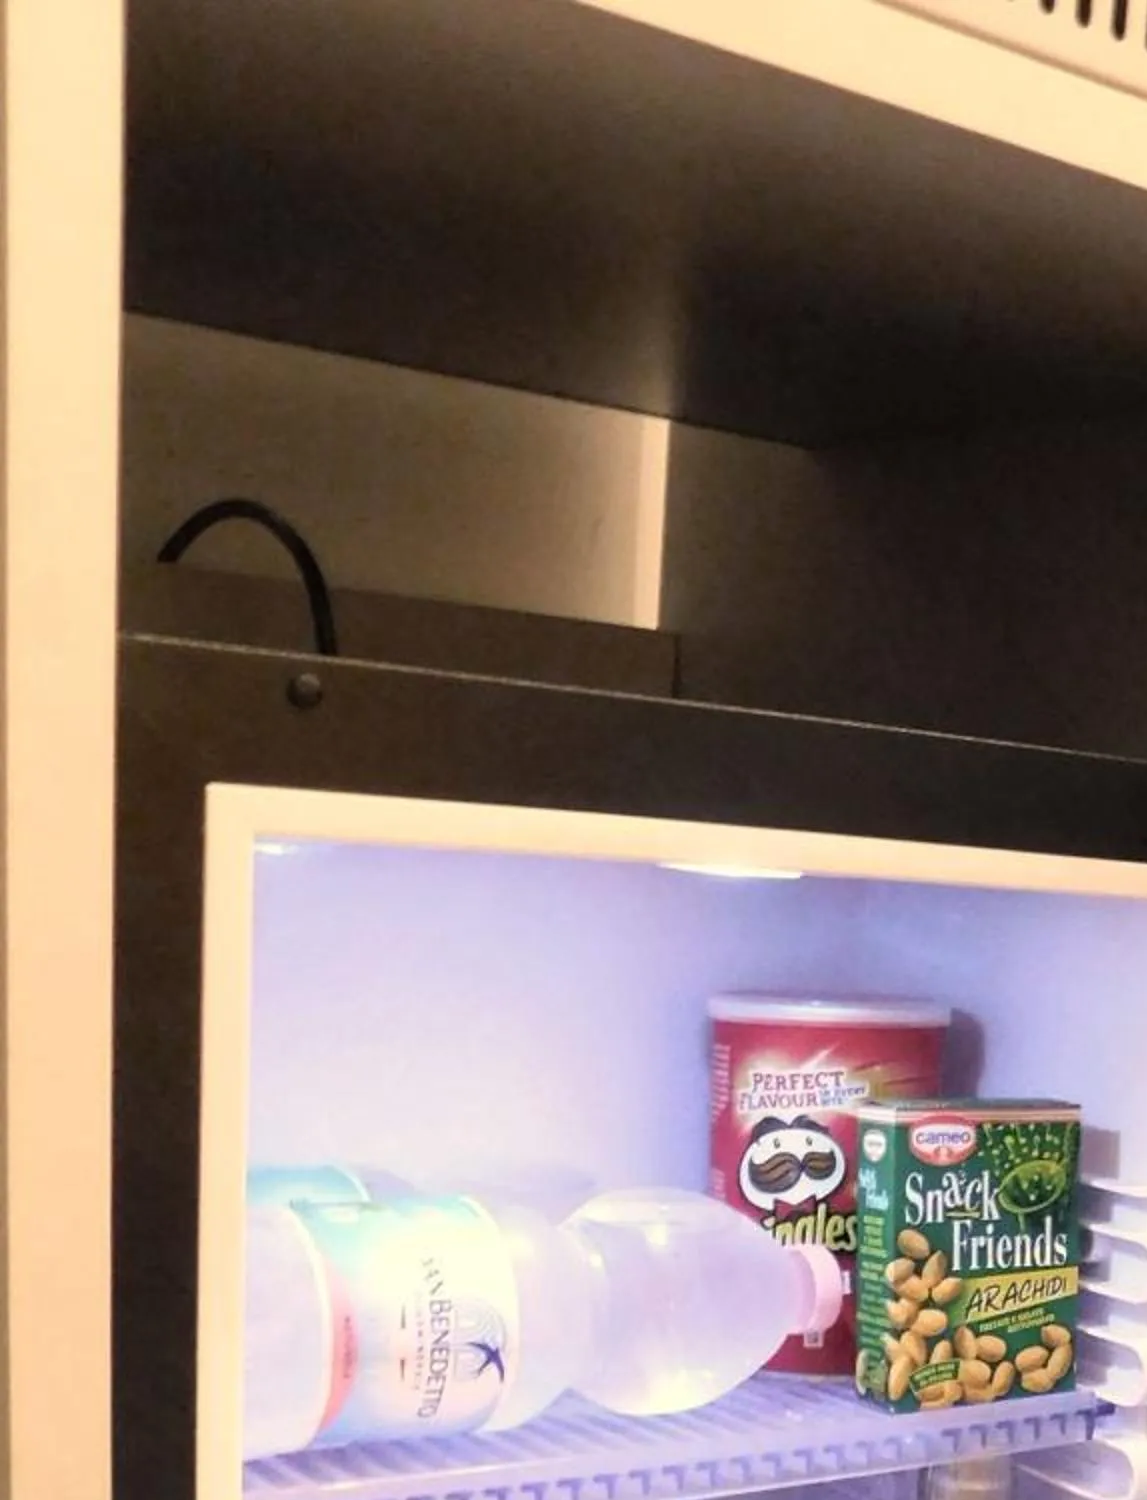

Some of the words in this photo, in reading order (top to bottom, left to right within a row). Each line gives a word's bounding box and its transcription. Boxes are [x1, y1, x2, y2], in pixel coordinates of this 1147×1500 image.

[740, 1092, 818, 1110] FLAVOUR
[751, 1071, 845, 1093] PERFECT
[916, 1132, 971, 1145] cameo
[904, 1168, 1001, 1226] Snack
[951, 1216, 1068, 1272] Friends
[965, 1276, 1069, 1319] ARACHIDI
[417, 1299, 452, 1418] BENEDETTO
